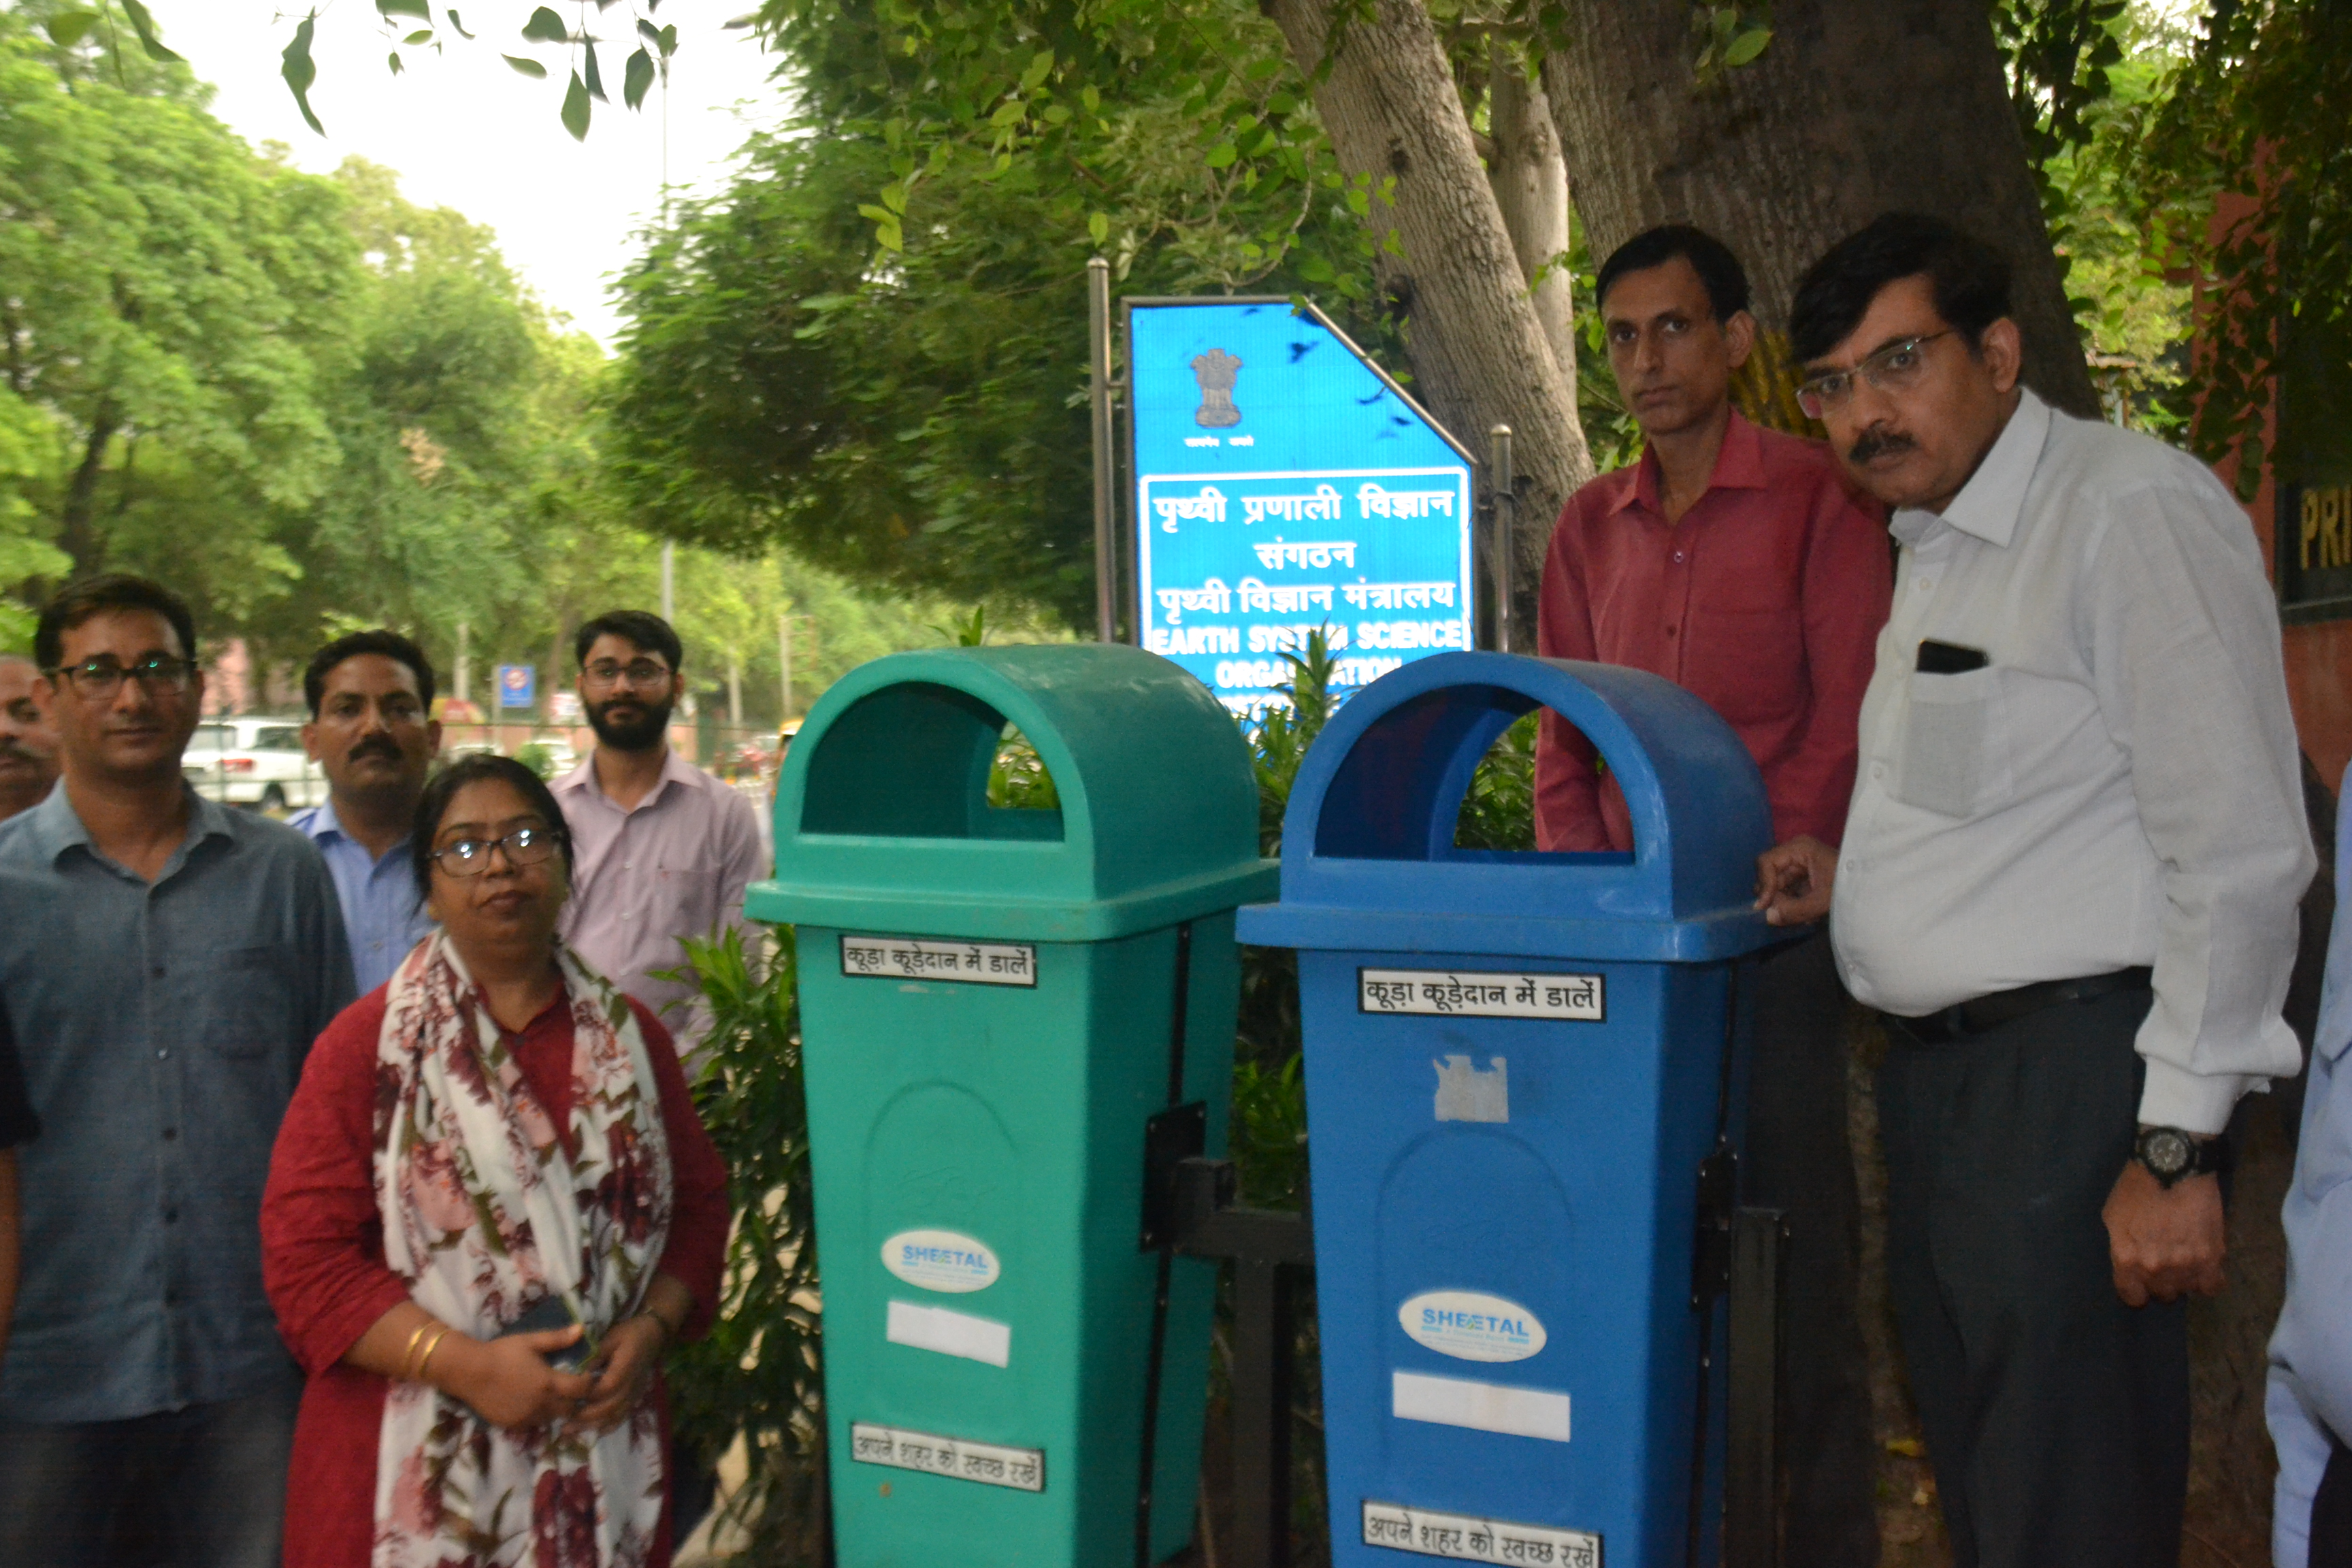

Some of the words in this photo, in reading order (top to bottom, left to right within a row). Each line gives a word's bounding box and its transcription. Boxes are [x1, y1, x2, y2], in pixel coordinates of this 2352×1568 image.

[1153, 487, 1226, 534] पृथ्वी
[1241, 485, 1342, 525] प्रणाली
[1356, 484, 1455, 520] विज्ञान
[1253, 536, 1357, 570] संगठन
[1156, 580, 1230, 625] पृथ्वी
[1237, 578, 1335, 613] विज्ञान
[1341, 577, 1456, 610] मंत्रालय
[1153, 627, 1240, 655] EARTH
[1248, 624, 1349, 653] SYSTM
[1357, 620, 1463, 651] SCIENCE
[845, 947, 885, 973] कूड़ा
[891, 943, 958, 975] कूड़ेदान
[965, 947, 981, 972] में
[1365, 981, 1414, 1011] कूड़ा
[1422, 975, 1507, 1012] कूड़ेदान
[1516, 978, 1536, 1007] में
[902, 1245, 988, 1269] SHEETAL
[1422, 1309, 1530, 1337] SHEETAL
[1369, 1513, 1413, 1545] अपने
[1420, 1525, 1463, 1554] शहर
[1469, 1524, 1494, 1557] को
[1501, 1537, 1554, 1565] स्वच्छ
